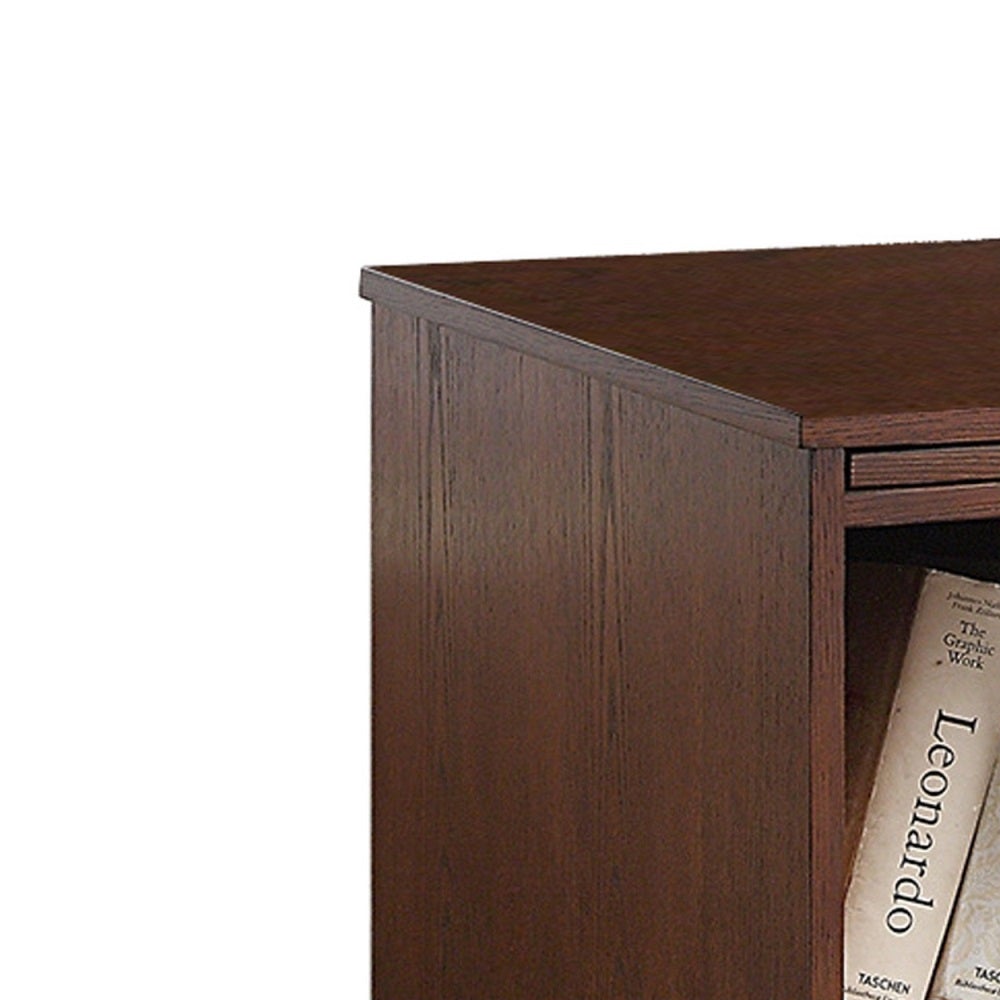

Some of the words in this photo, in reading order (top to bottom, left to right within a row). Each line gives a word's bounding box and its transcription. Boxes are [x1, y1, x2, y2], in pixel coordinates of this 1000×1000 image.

[960, 620, 987, 639] The
[943, 632, 996, 656] Graphic
[948, 650, 983, 670] Work
[886, 709, 978, 934] Leonardo
[859, 972, 911, 994] TASCHEN
